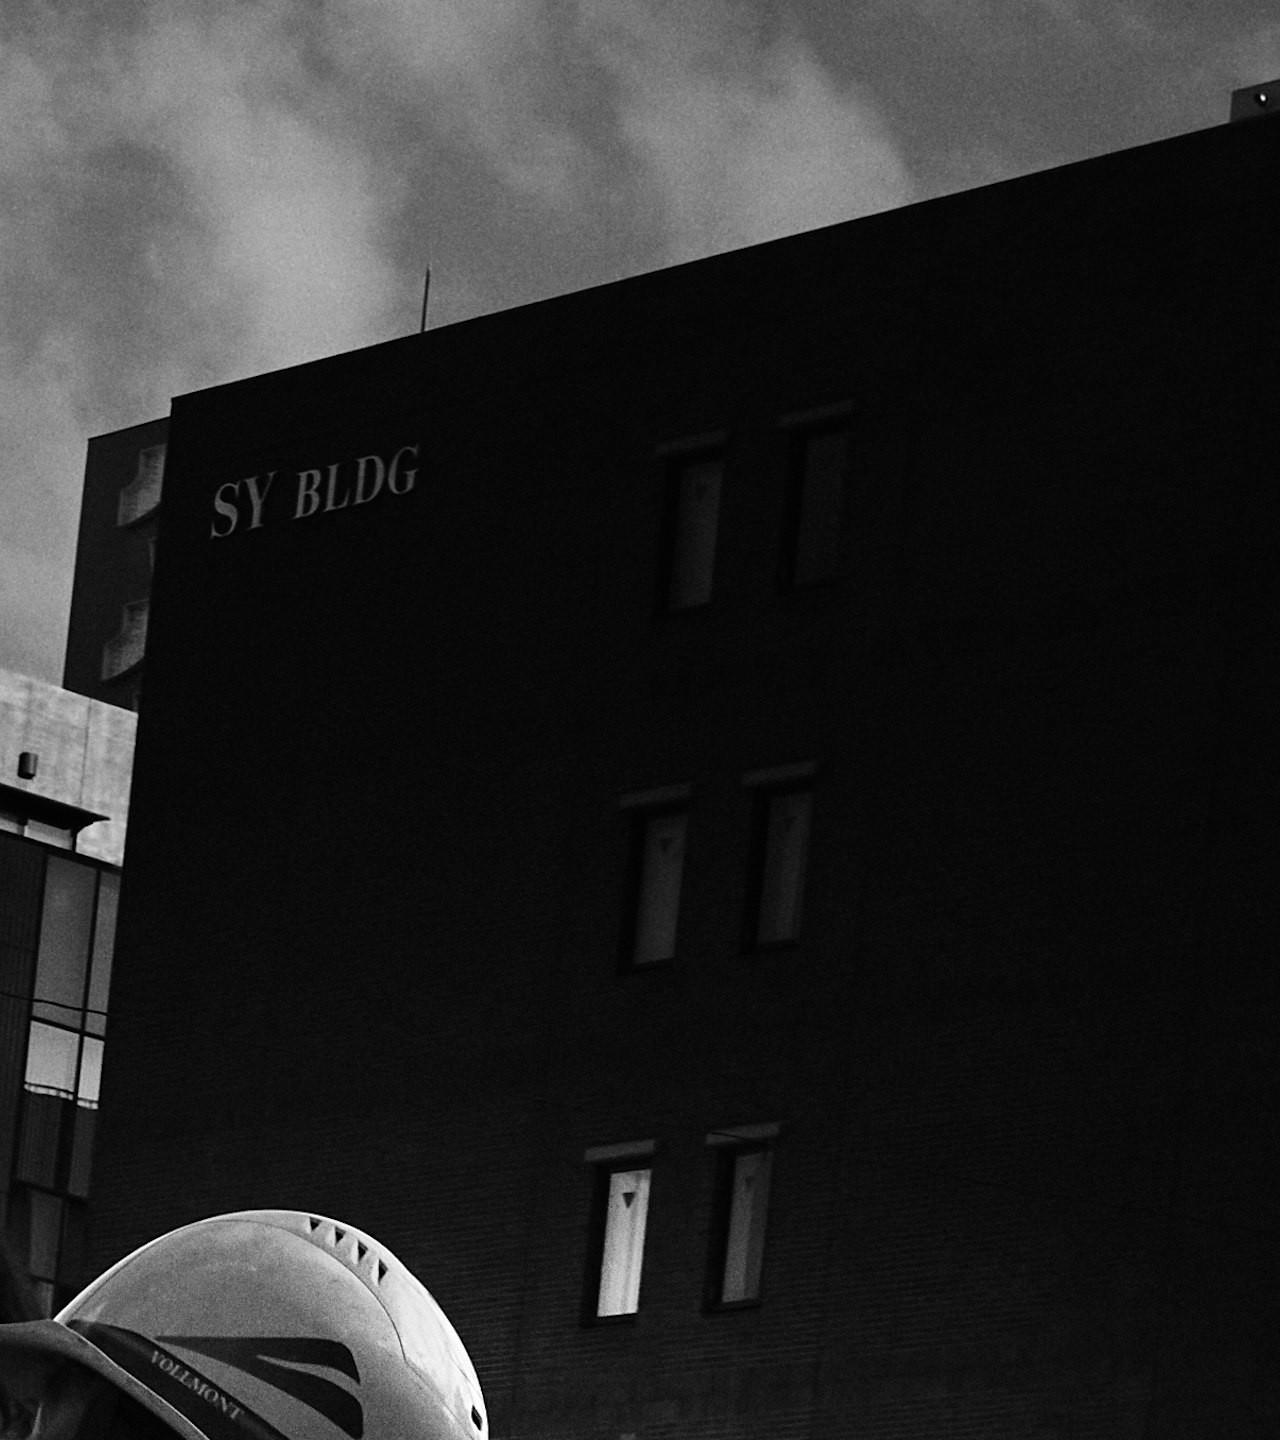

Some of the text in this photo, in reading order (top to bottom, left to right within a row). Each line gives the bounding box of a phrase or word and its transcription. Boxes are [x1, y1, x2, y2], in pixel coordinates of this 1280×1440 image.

[209, 443, 421, 540] SY BLDG
[150, 1350, 246, 1420] VOLLMONT
